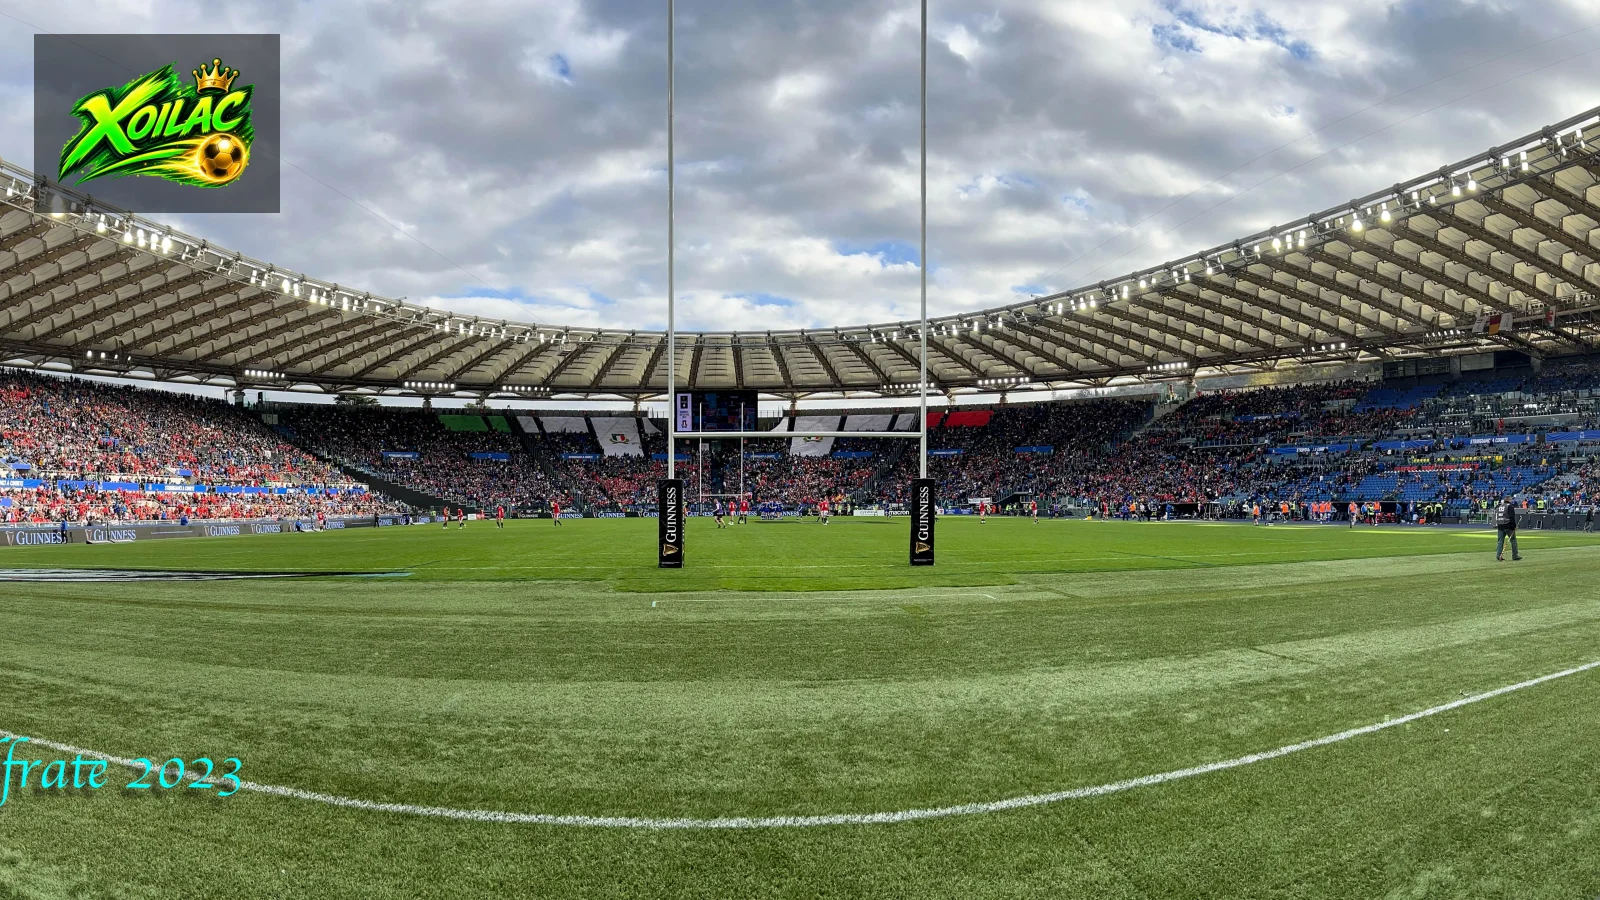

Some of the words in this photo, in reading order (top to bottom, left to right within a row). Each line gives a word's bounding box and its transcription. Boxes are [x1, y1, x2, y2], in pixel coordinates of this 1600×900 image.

[666, 487, 677, 543] GUINNESS
[917, 486, 929, 541] GUINNESS
[210, 525, 240, 537] GUINNESS
[256, 523, 281, 534] GUINNESS
[16, 531, 66, 545] GUINNES
